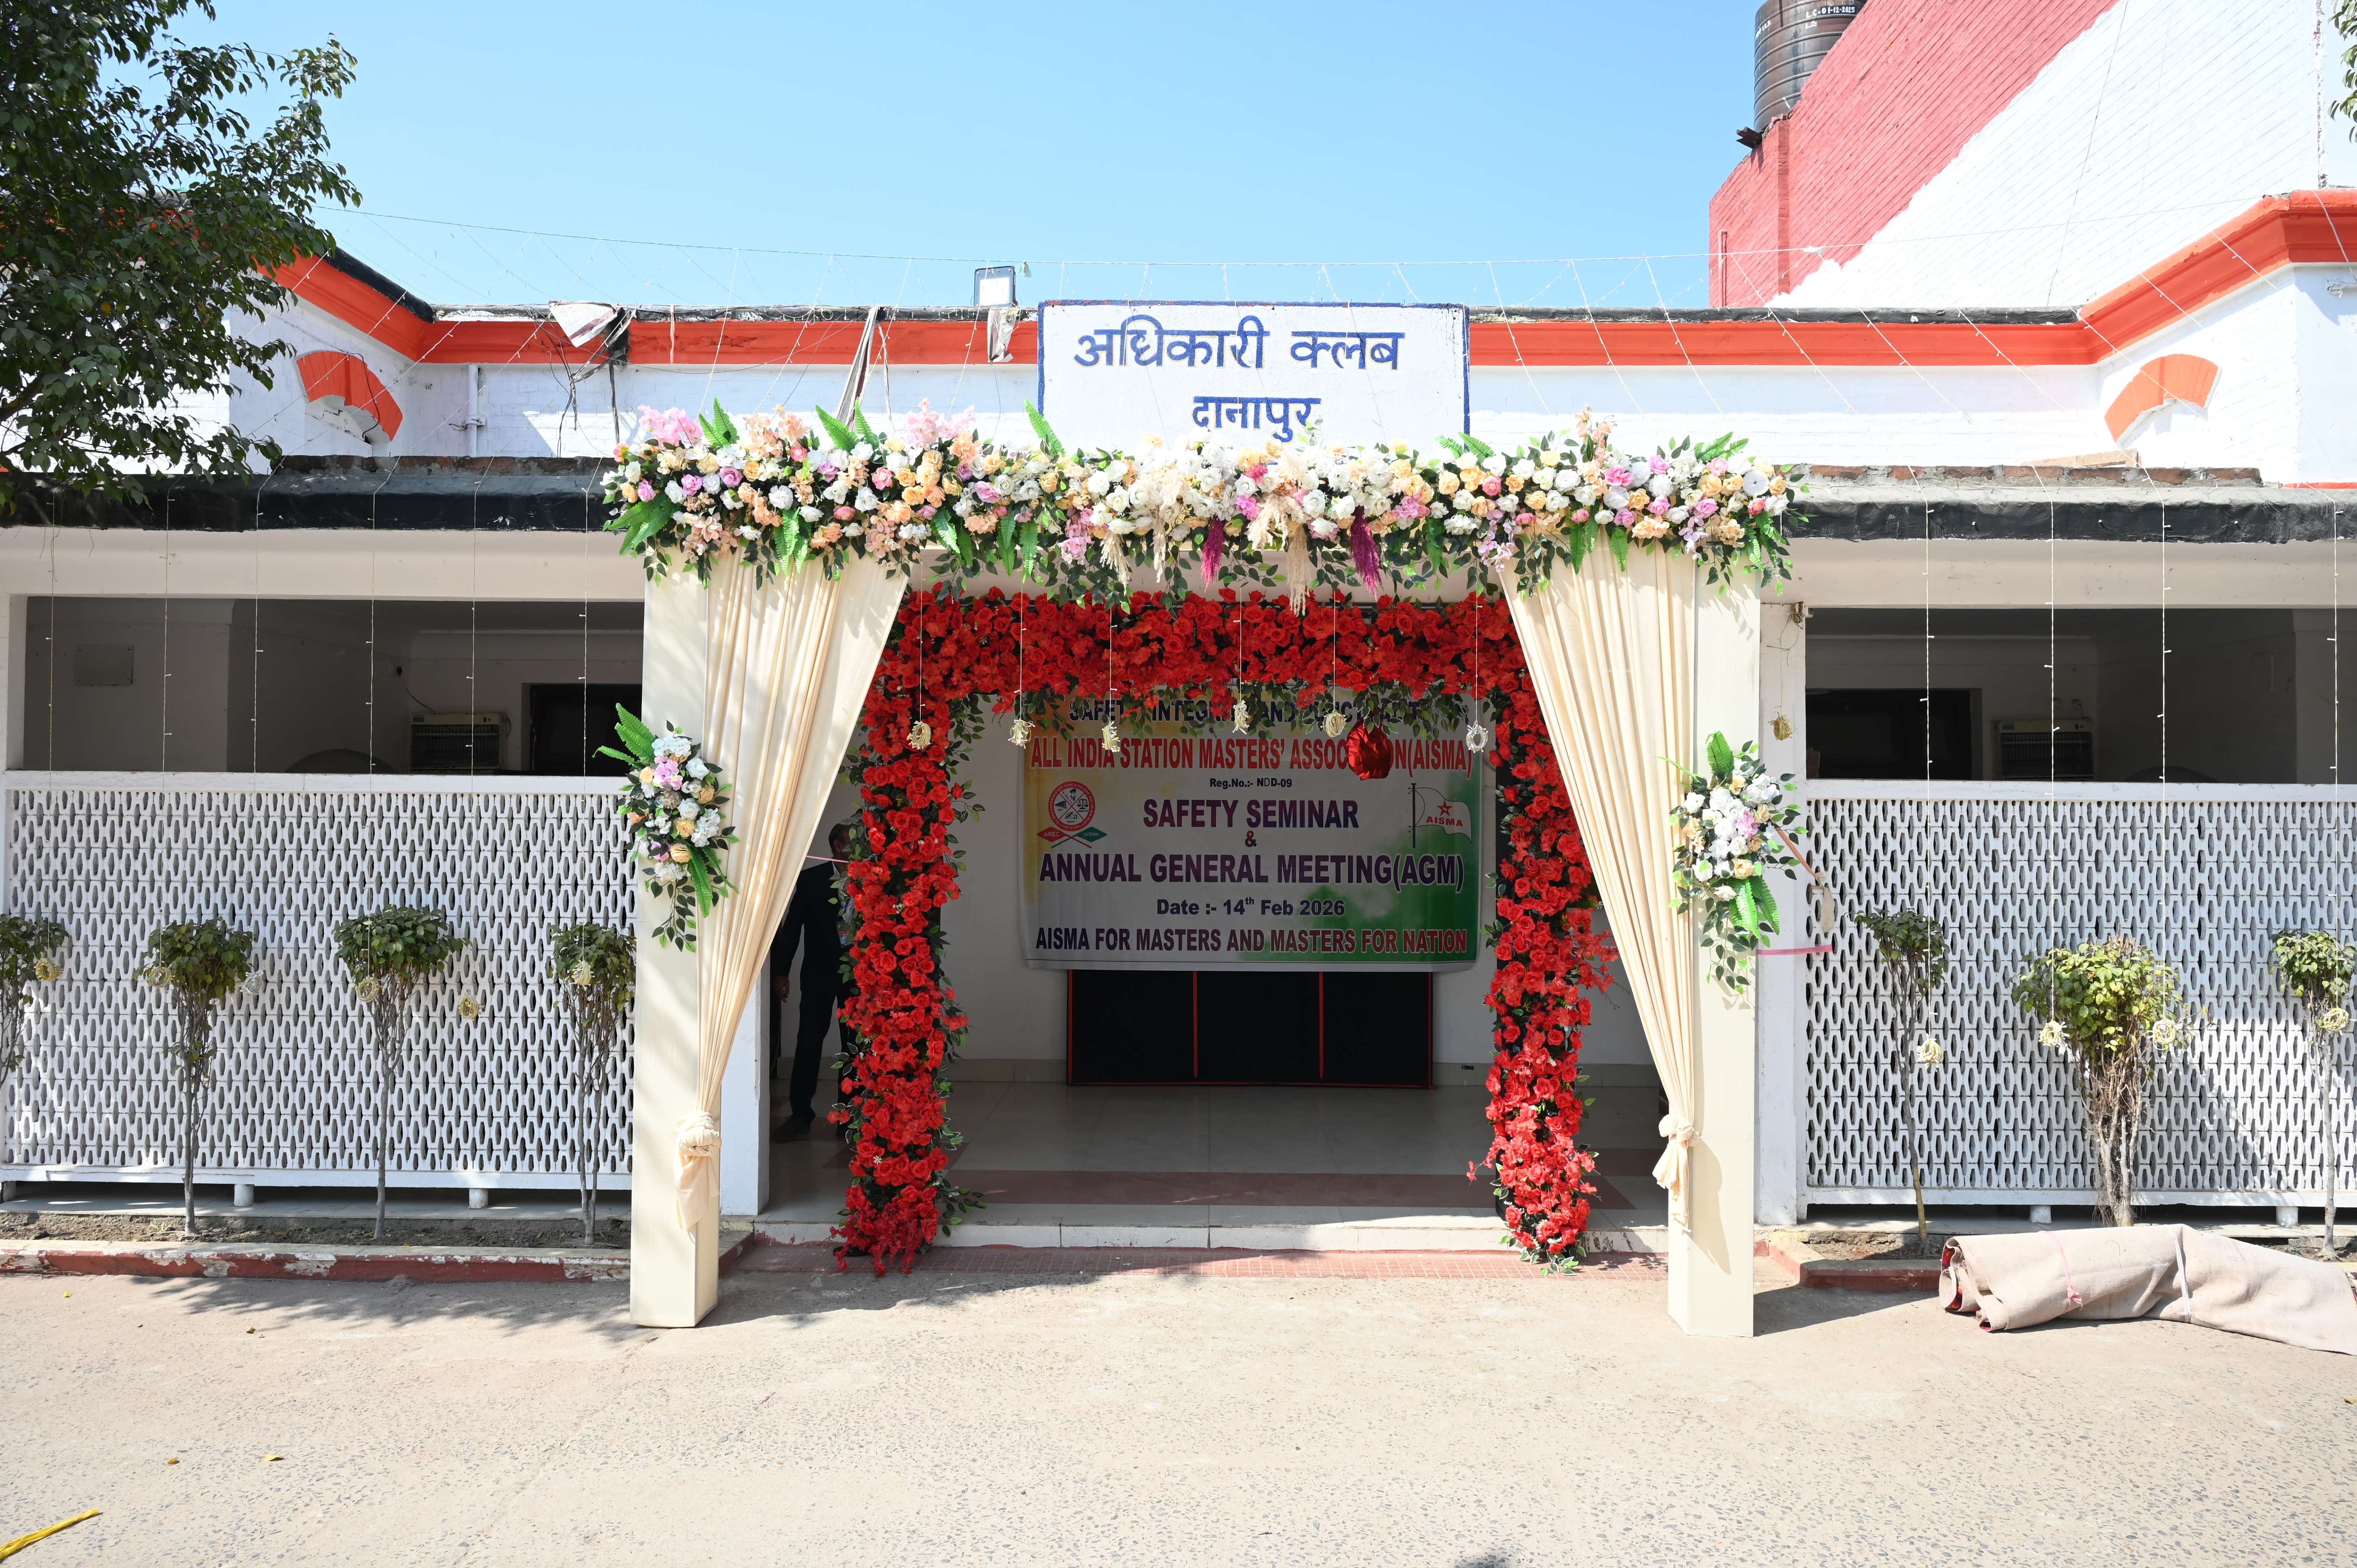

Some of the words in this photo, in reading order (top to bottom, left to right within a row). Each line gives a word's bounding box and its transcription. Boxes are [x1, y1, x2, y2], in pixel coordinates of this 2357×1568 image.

[1074, 314, 1271, 368] अधिकारी
[1290, 331, 1405, 370] क्लब
[1193, 396, 1321, 443] दानापुर
[1031, 738, 1062, 767] ALL
[1067, 738, 1115, 768] INDIA
[1120, 738, 1193, 769] STATION
[1257, 778, 1292, 787] NDD-09
[1143, 799, 1239, 828] SAFETY
[1246, 799, 1359, 828] SEMINAR
[1426, 816, 1463, 827] AISMA
[1245, 830, 1257, 847] &
[1039, 853, 1141, 882] ANNUAL
[1150, 854, 1269, 883] GENERAL
[1277, 854, 1464, 892] MEETING(AGM)
[1157, 899, 1199, 915] Date
[1261, 900, 1294, 915] Feb
[1299, 900, 1345, 916] 2026
[1036, 927, 1090, 950] AISMA
[1095, 928, 1130, 950] FOR
[1136, 928, 1221, 951] MASTERS
[1227, 929, 1264, 952] AND
[1271, 929, 1356, 952] MASTERS
[1362, 929, 1397, 952] FOR
[1403, 929, 1467, 952] NATION
